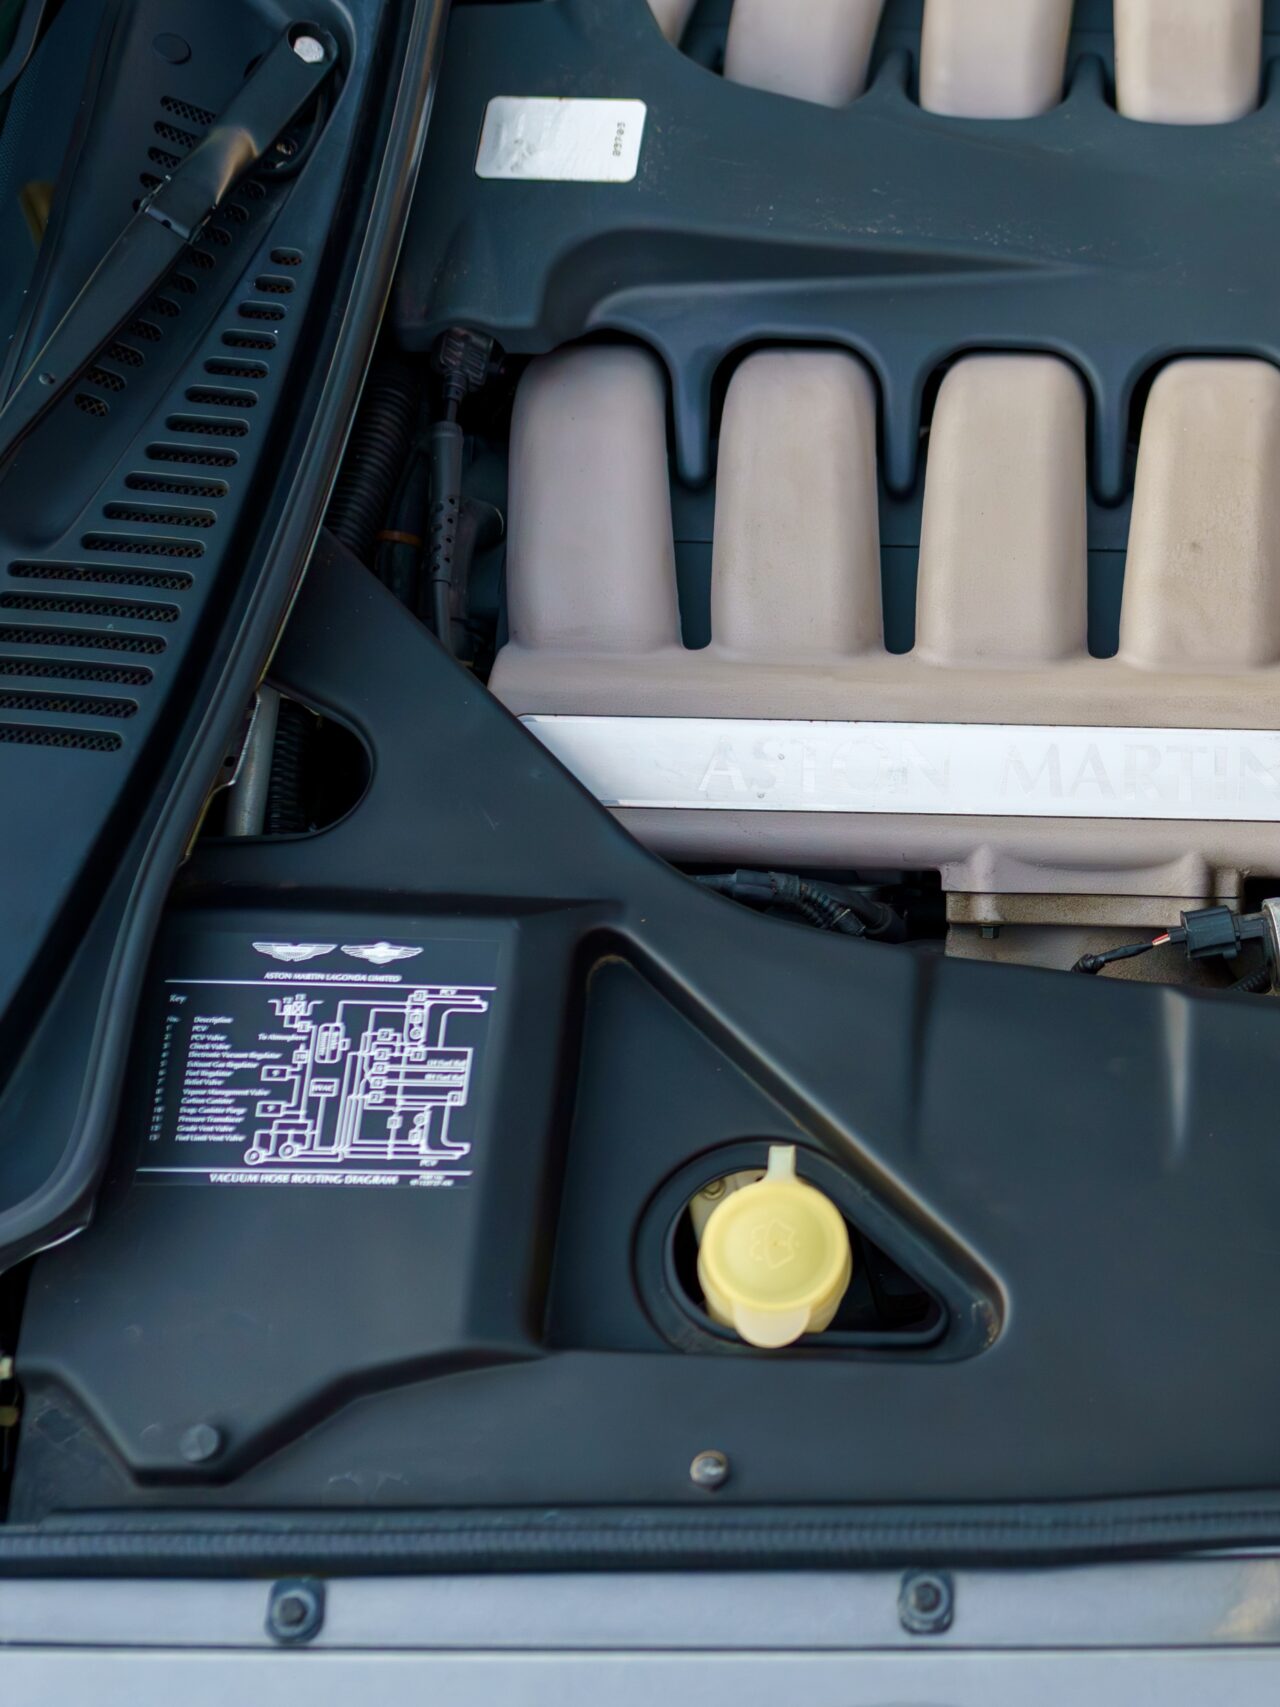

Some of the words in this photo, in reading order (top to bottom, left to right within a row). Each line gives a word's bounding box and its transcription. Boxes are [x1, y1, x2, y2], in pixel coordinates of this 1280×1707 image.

[699, 736, 953, 798] ASTON
[264, 972, 292, 981] ASTON
[292, 973, 325, 982] MARTIN
[325, 974, 366, 982] LAGONDA
[366, 975, 401, 983] LIMITED
[170, 994, 187, 1004] Key
[194, 1016, 234, 1025] Description
[190, 1042, 211, 1050] Check
[210, 1042, 232, 1050] Valve
[224, 1134, 246, 1142] Valve
[210, 1174, 258, 1184] VACUUM
[259, 1174, 289, 1185] HOSE
[290, 1175, 343, 1185] ROUTING
[343, 1175, 398, 1186] DIAGRAM
